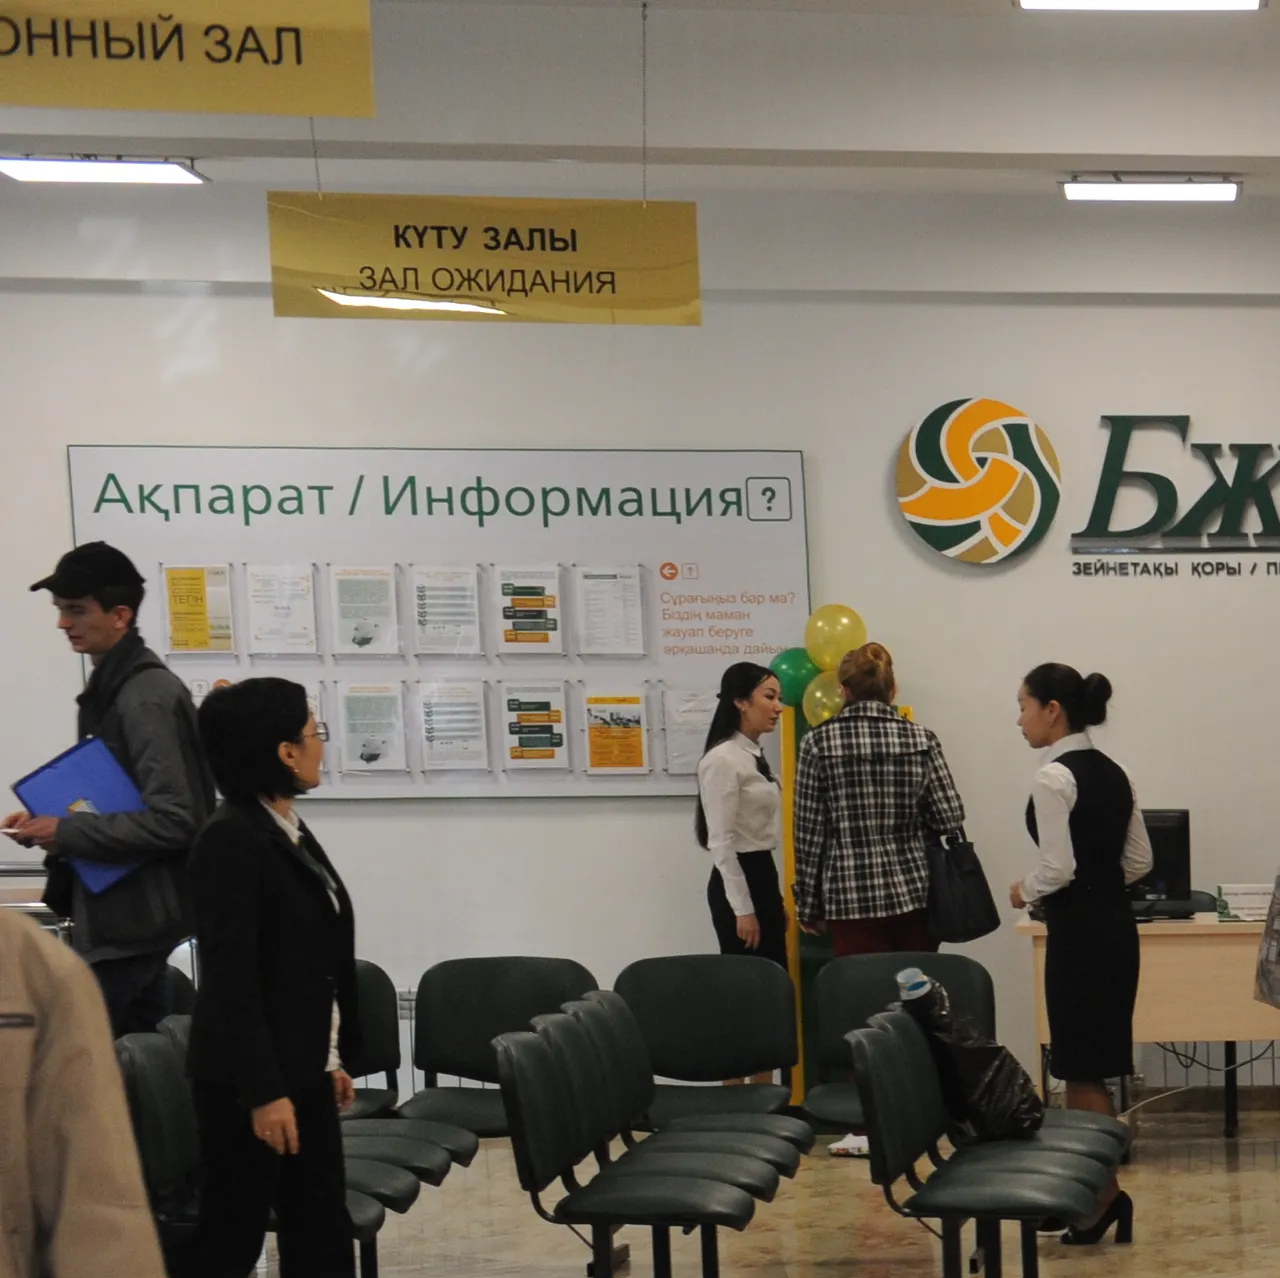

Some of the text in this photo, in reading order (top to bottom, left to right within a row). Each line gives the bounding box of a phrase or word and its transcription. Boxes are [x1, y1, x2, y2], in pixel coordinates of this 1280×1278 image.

[203, 24, 303, 65] ЗАЛ
[394, 224, 578, 252] КҮТУ ЗАЛЫ
[359, 265, 616, 298] ЗАЛ ОЖИДАНИЯ
[92, 472, 335, 527] Ақпарат
[347, 474, 365, 516] /
[382, 475, 744, 528] Информация
[1071, 558, 1179, 579] ЗЕЙНЕТАҚЫ
[1191, 561, 1242, 579] ҚОРЫ
[1249, 562, 1258, 577] /
[740, 591, 766, 605] бар
[769, 592, 796, 604] ма?
